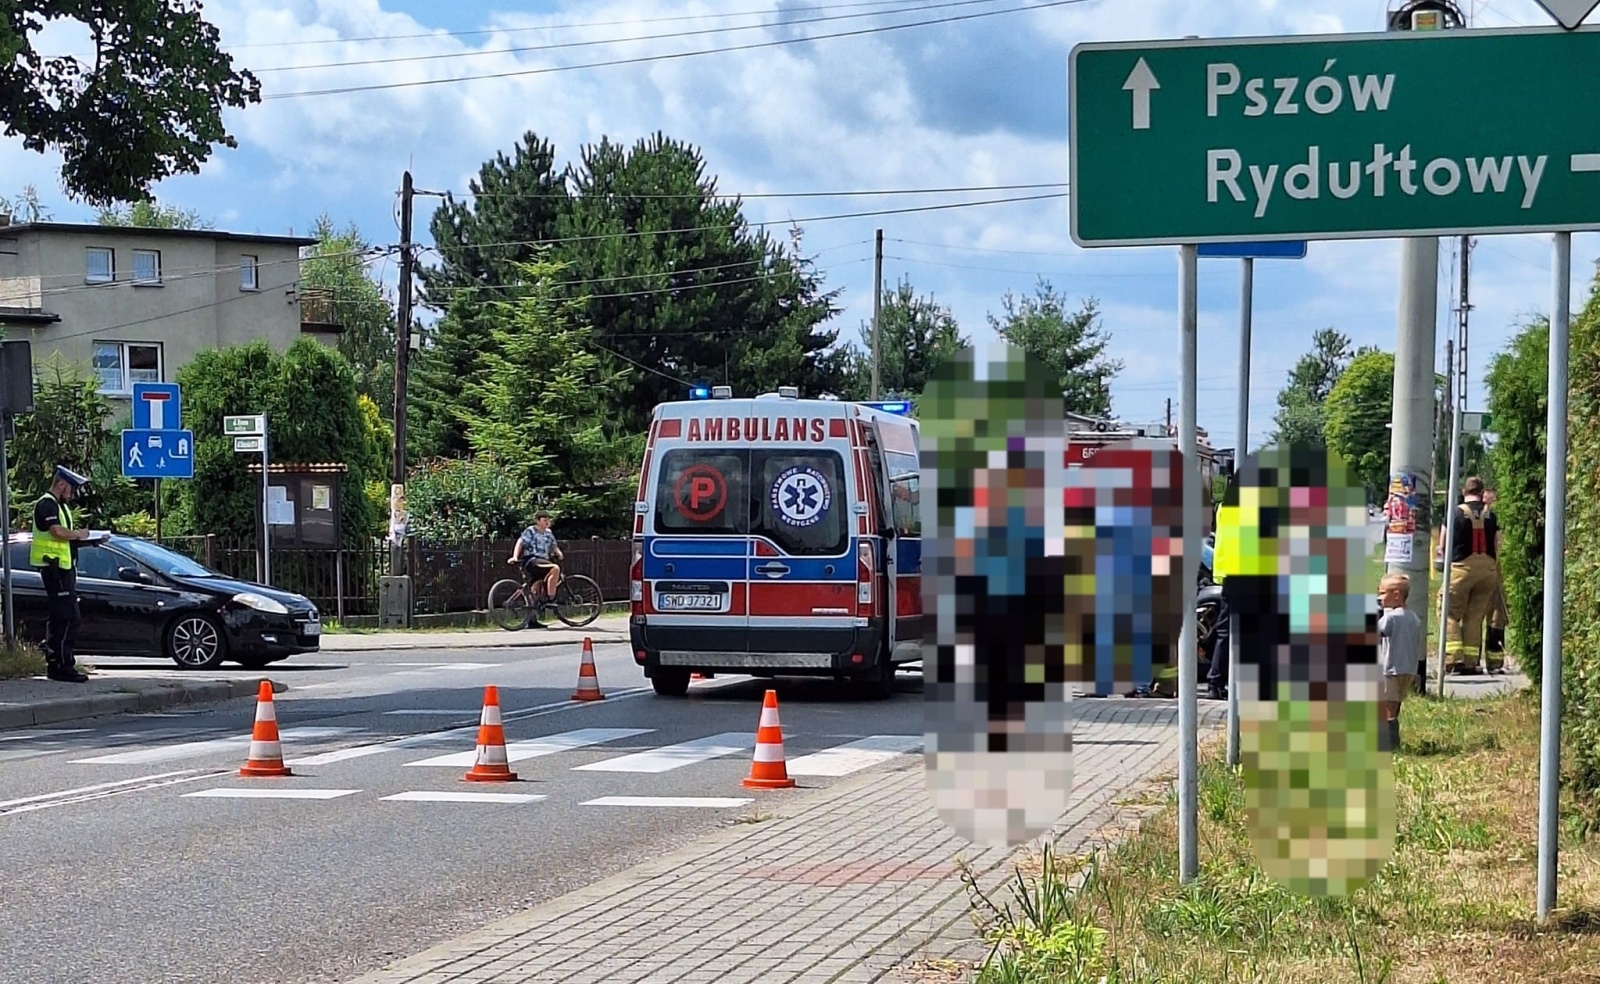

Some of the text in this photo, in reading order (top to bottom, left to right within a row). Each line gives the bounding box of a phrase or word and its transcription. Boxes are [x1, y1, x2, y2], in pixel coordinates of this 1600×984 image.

[1207, 58, 1396, 117] Pszów
[1207, 143, 1548, 218] Rydułtowy
[687, 417, 825, 443] AMBULANS
[690, 476, 715, 509] P
[664, 595, 718, 607] SWD 37321
